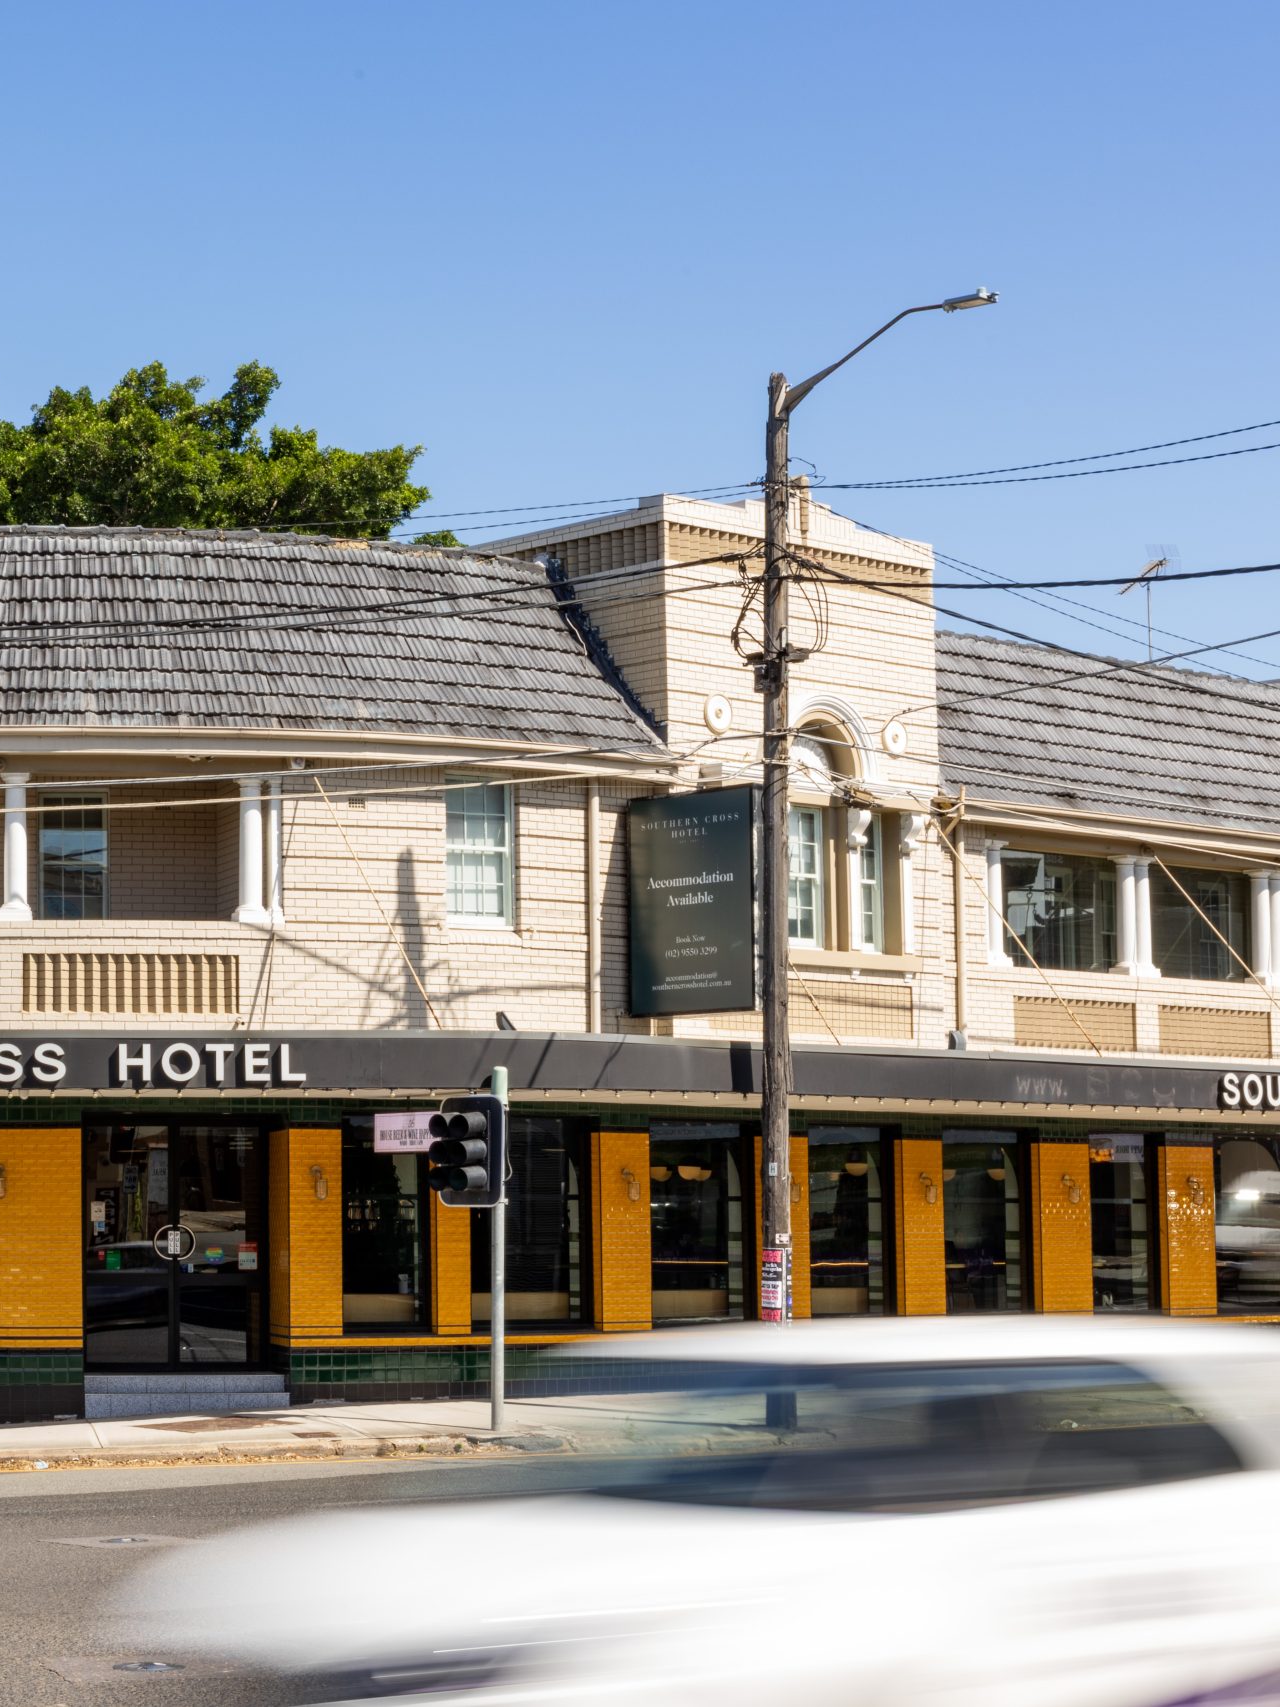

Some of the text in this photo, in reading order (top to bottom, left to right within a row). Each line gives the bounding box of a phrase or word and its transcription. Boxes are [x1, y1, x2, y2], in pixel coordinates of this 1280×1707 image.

[640, 812, 740, 831] SOUTHERN CROSS
[671, 827, 708, 838] HOTEL
[647, 870, 734, 889] Accommodation
[666, 891, 714, 907] Available
[675, 934, 706, 944] Book Now
[665, 948, 680, 959] (02)
[681, 947, 699, 957] 9550
[118, 1042, 307, 1082] HOTEL
